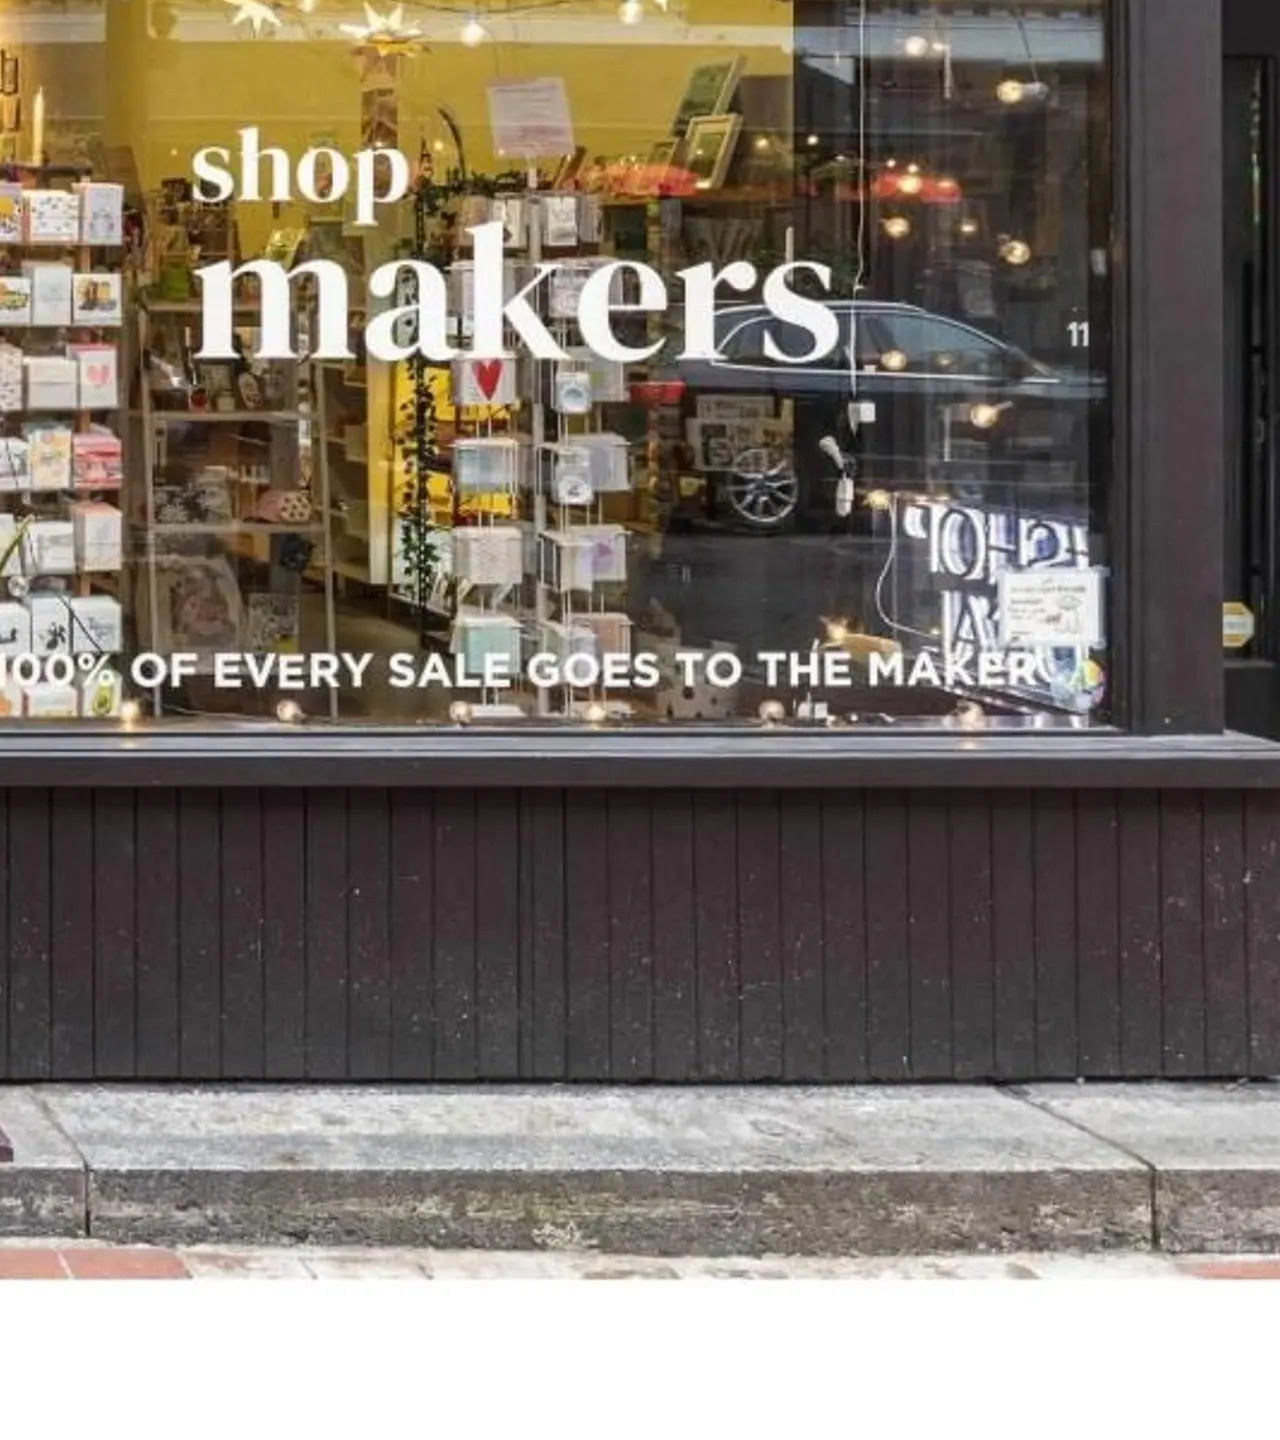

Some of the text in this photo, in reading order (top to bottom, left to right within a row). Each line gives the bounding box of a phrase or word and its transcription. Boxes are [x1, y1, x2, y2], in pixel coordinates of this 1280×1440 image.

[190, 126, 410, 226] shop
[192, 220, 841, 362] makers
[130, 651, 199, 689] OF
[213, 651, 372, 689] EVERY
[387, 651, 511, 689] SALE
[526, 651, 661, 689] GOES
[675, 651, 743, 689] TO
[756, 651, 851, 689] THE
